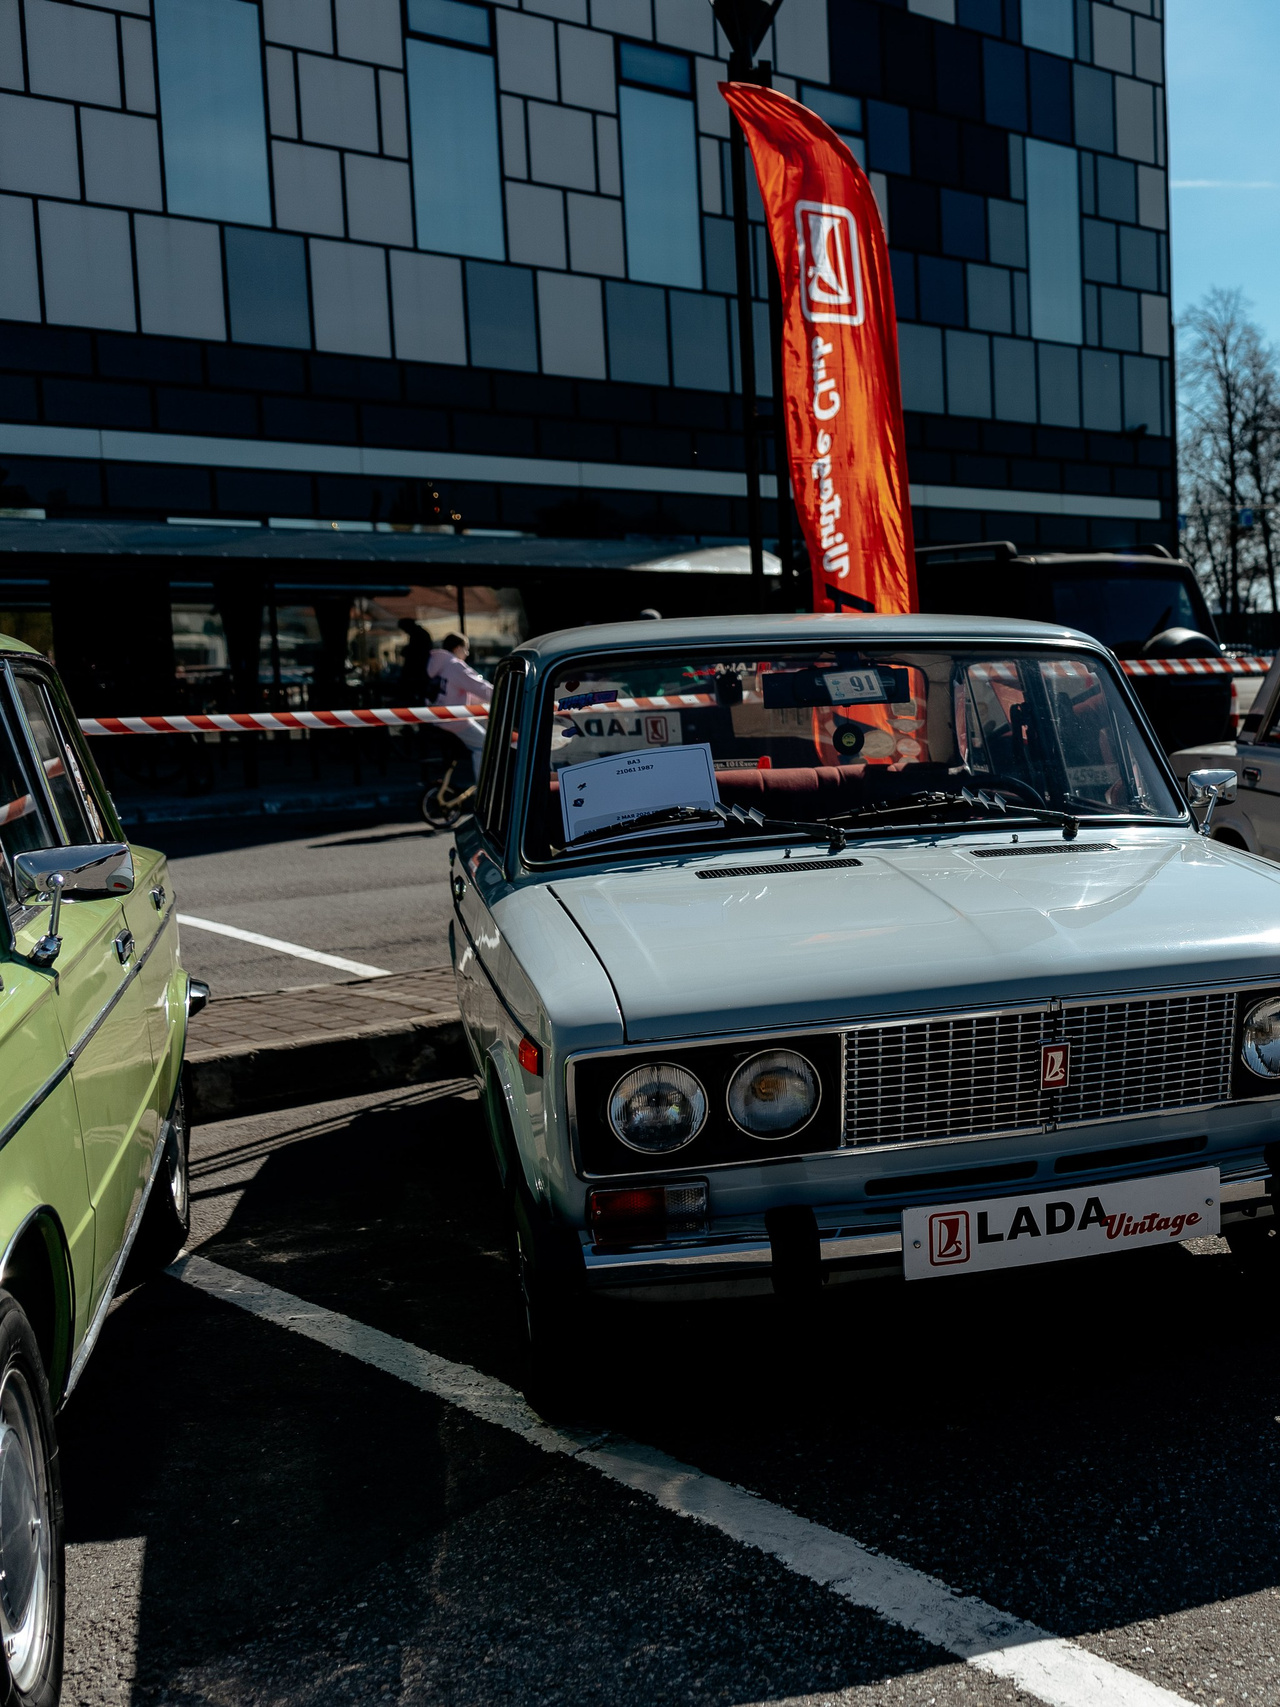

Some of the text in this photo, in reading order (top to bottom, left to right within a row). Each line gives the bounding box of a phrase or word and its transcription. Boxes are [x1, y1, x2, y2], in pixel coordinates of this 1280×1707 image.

[849, 675, 875, 692] 91
[627, 758, 641, 766] ВАЗ
[616, 764, 654, 775] 21061 1987
[976, 1196, 1202, 1245] LADA Vintage
